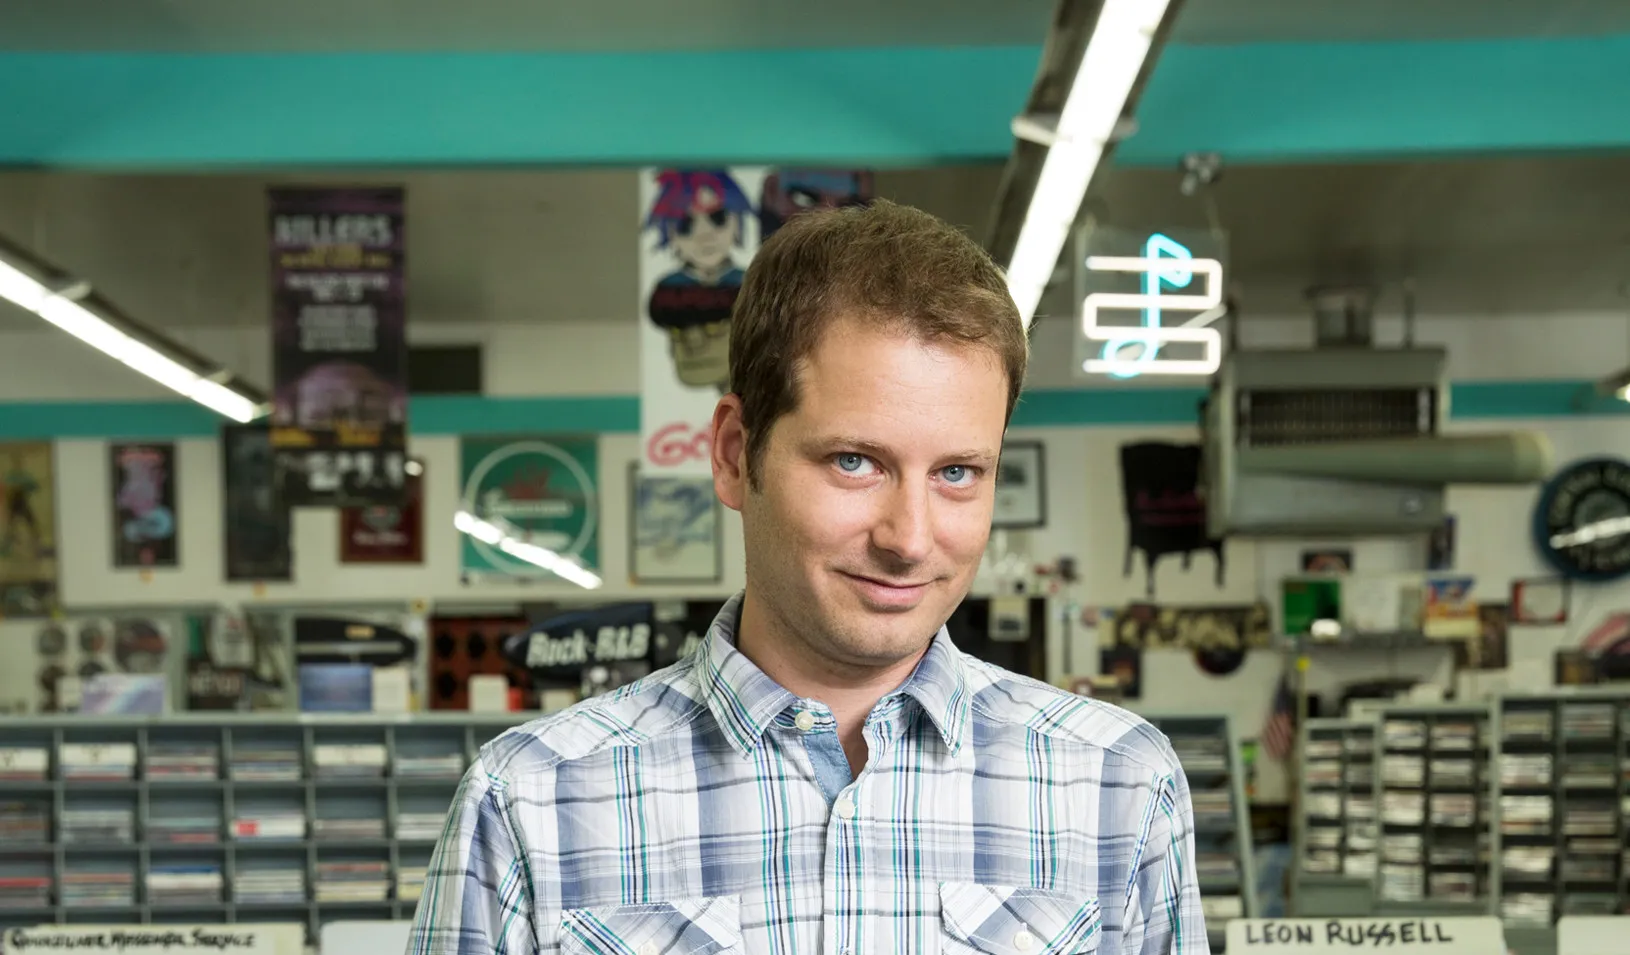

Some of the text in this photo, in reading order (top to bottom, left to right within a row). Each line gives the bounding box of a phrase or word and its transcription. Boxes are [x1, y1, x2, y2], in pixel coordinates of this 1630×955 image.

[526, 630, 588, 667] Rock
[1246, 920, 1453, 946] LEON RUSSELL
